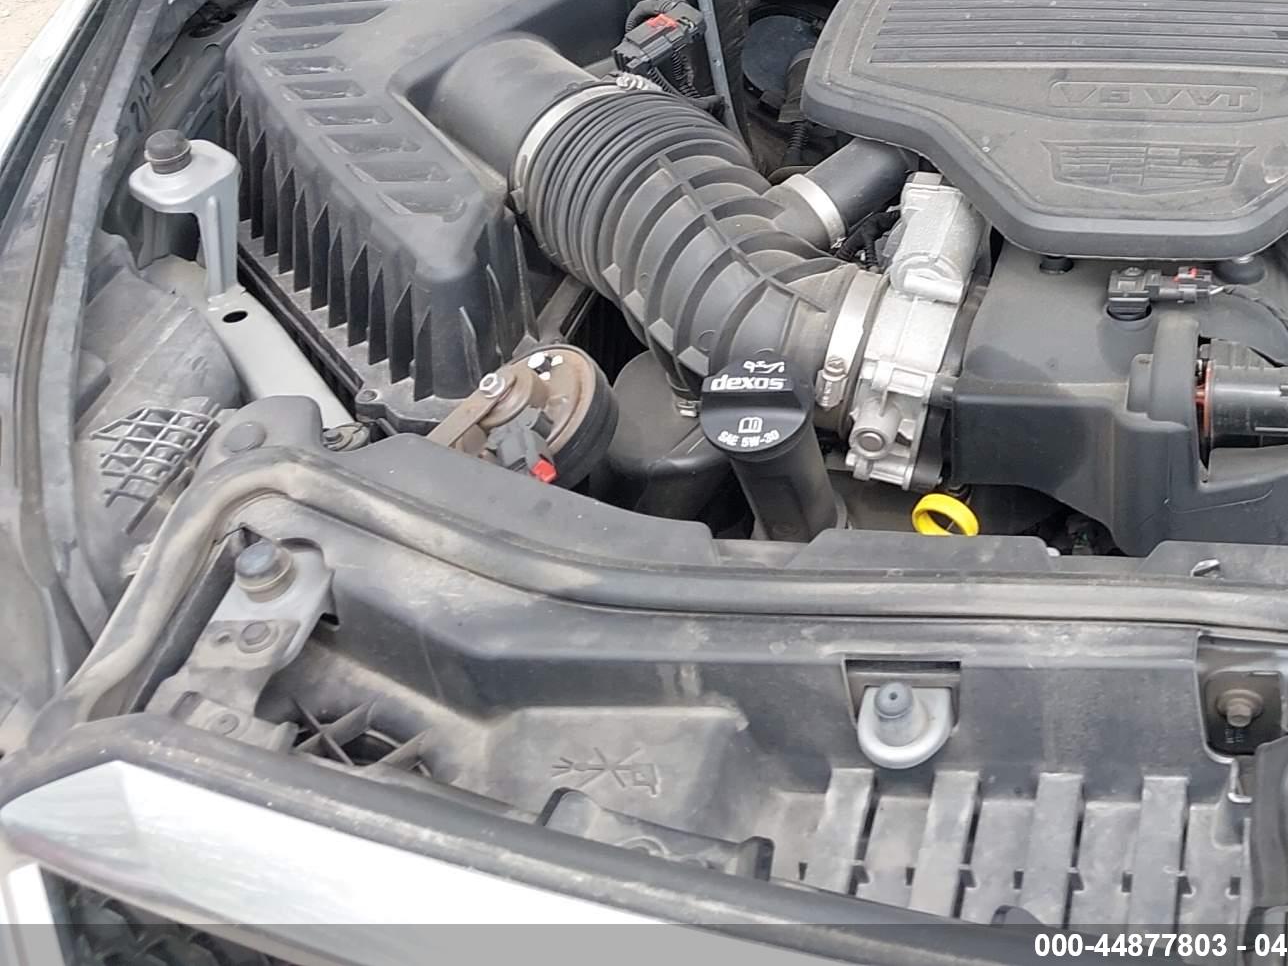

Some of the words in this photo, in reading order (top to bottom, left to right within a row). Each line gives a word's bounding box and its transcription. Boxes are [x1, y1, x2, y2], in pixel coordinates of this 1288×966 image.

[1059, 86, 1131, 104] V6
[1143, 88, 1253, 107] VVT
[710, 374, 787, 391] dexos
[717, 430, 740, 446] SAE
[741, 429, 780, 447] 5W-30
